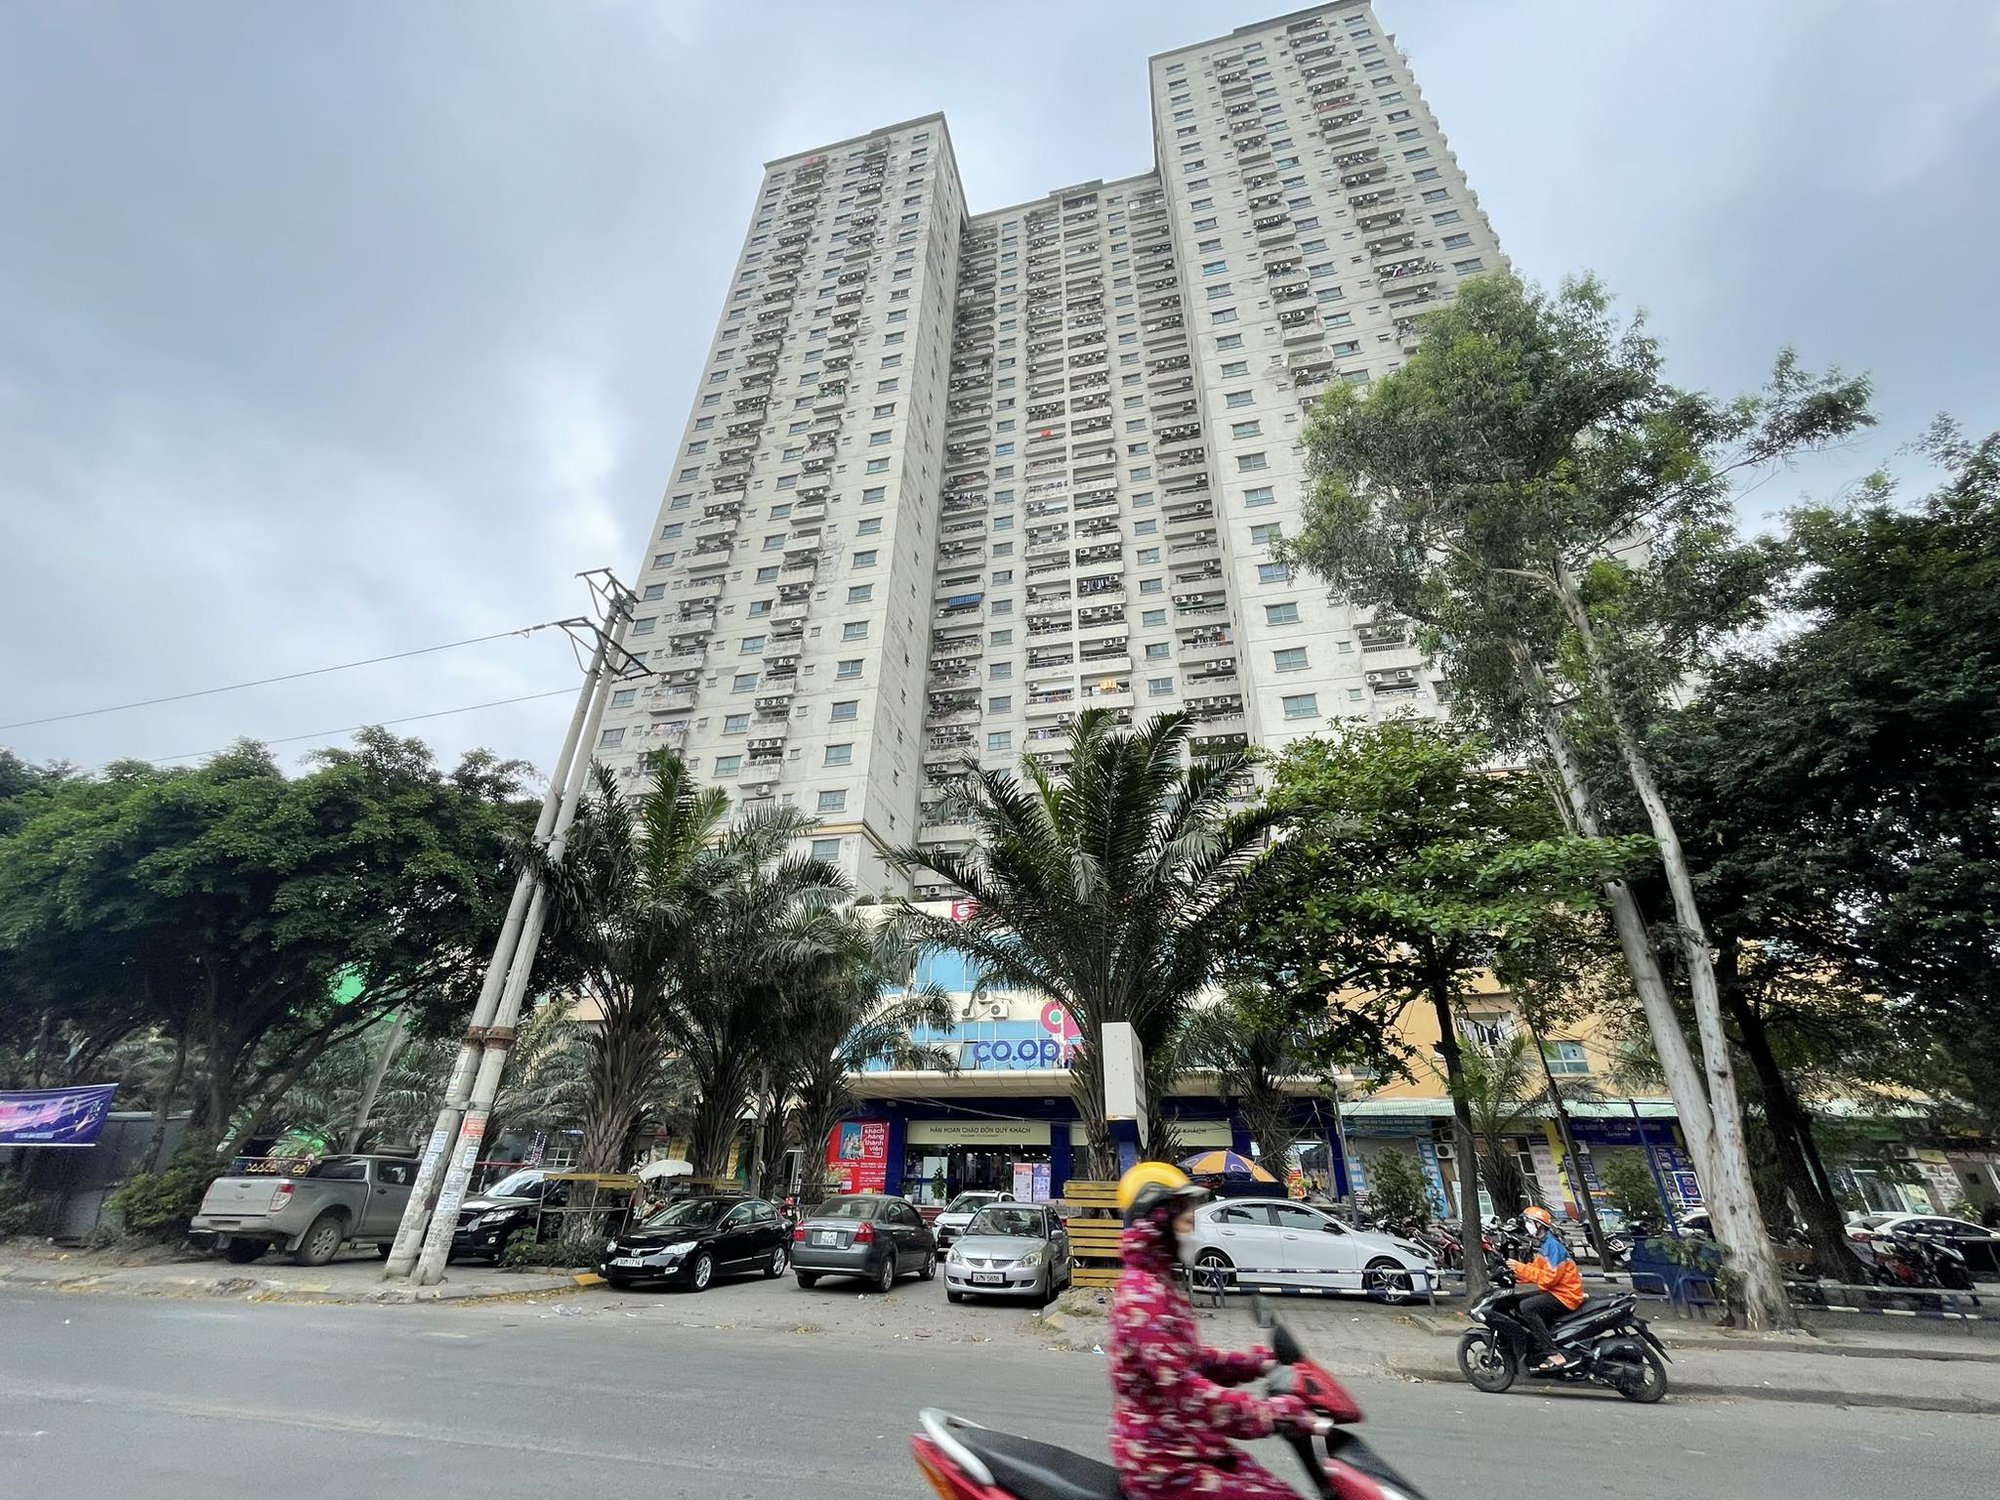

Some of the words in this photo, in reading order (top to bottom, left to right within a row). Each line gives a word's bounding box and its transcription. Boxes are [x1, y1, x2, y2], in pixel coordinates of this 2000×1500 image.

[962, 1125, 980, 1133] CHÀO
[980, 1125, 994, 1133] ĐÓN
[995, 1125, 1008, 1133] QUÝ
